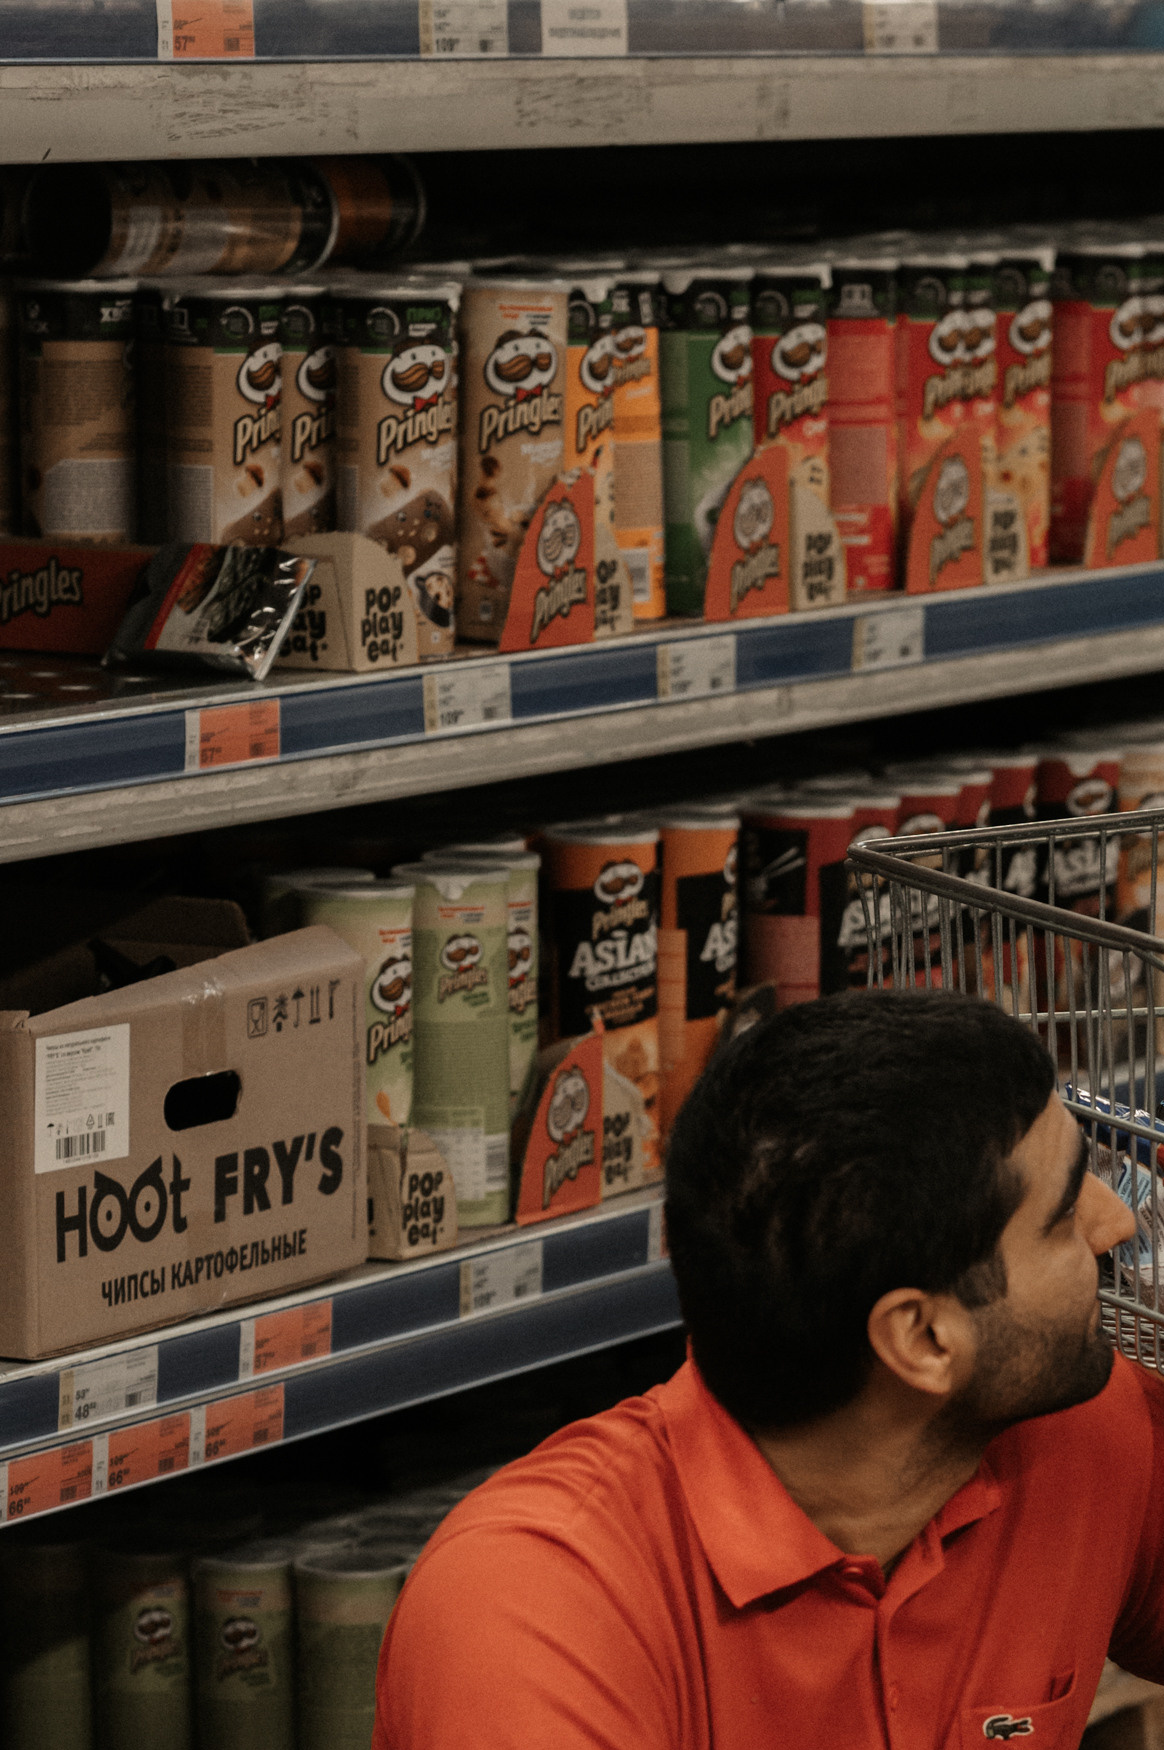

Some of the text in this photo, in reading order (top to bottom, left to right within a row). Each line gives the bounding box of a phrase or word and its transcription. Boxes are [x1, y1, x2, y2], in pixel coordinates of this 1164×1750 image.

[361, 611, 403, 646] play
[530, 569, 587, 644] Pringles
[213, 1126, 345, 1224] FRY'S
[403, 1195, 445, 1229] play
[101, 1228, 308, 1307] ЧИПСЫ КАРТОФЕЛЬНЫЕ
